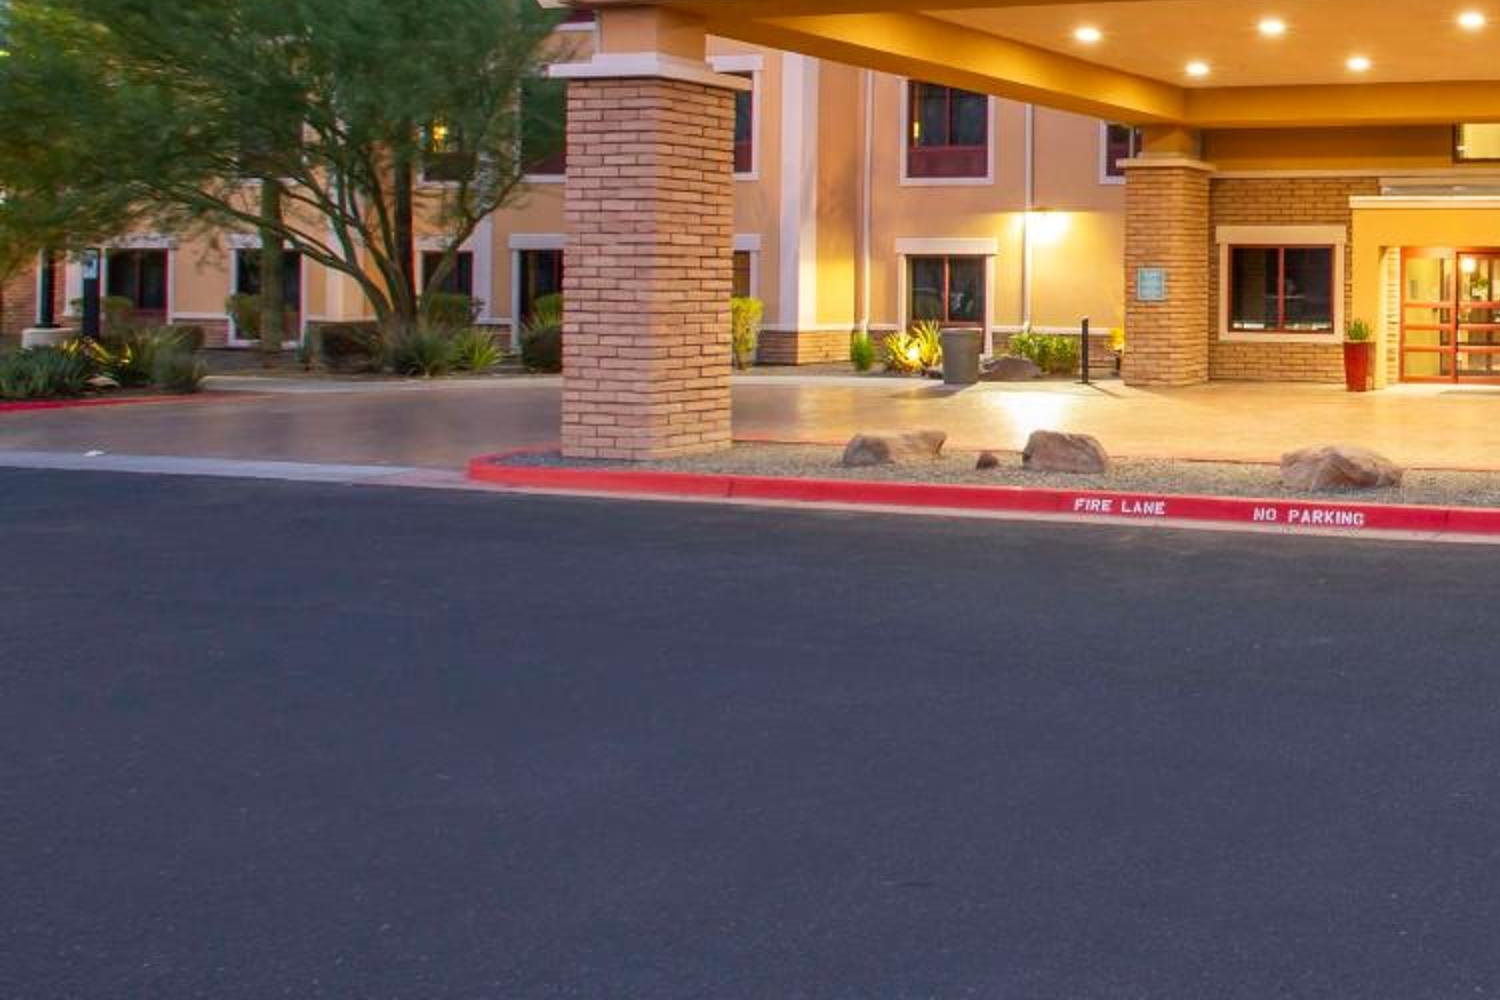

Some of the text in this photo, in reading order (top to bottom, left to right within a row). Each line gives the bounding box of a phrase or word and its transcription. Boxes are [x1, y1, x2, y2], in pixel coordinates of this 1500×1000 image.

[1074, 498, 1165, 515] FIRE LANE
[1253, 507, 1365, 525] NO PARKING
